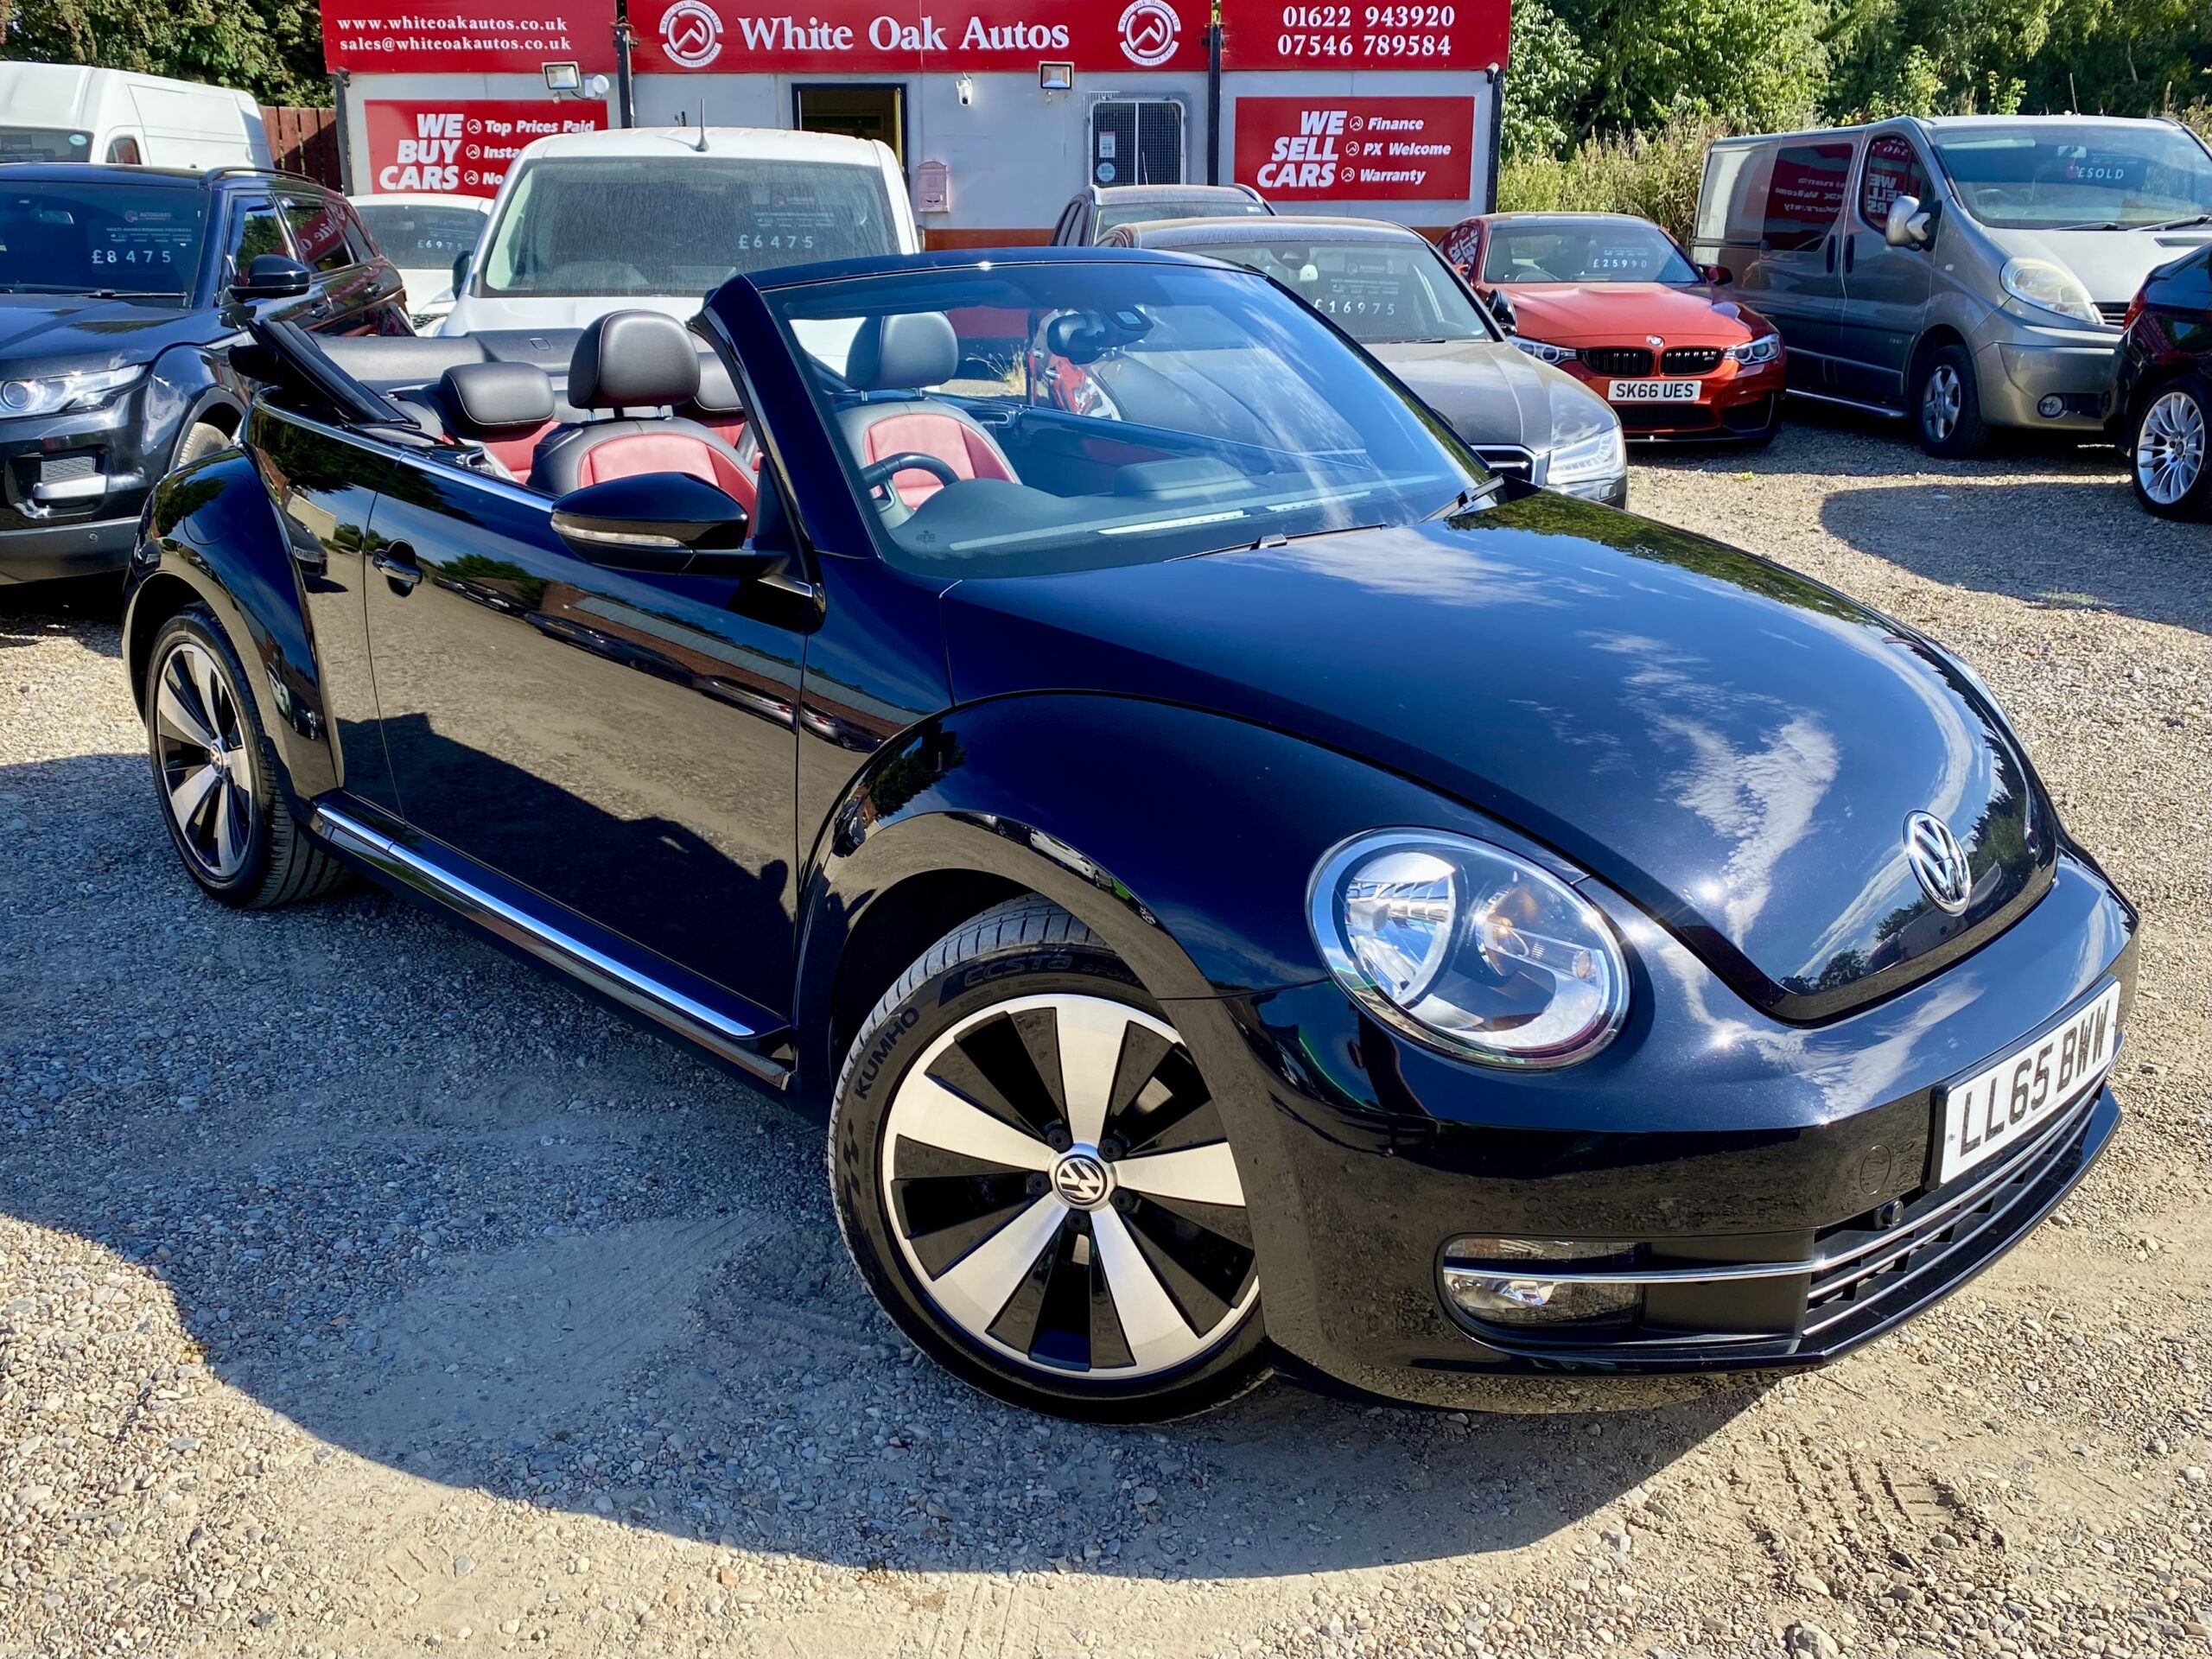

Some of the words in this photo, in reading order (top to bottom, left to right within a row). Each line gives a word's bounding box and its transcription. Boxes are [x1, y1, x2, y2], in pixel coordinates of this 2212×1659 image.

[337, 16, 567, 31] www.whiteoakautos.co.uk
[1282, 6, 1351, 27] 01622
[1365, 6, 1455, 28] 943920
[737, 16, 855, 50] White
[868, 16, 948, 50] Oak
[958, 16, 1070, 50] Autos
[340, 36, 571, 52] sales@whiteoakautos.co.uk
[1277, 35, 1353, 56] 07546
[1363, 35, 1452, 56] 789584
[416, 113, 464, 138] WE
[485, 120, 512, 137] Top
[516, 120, 558, 133] Prices
[563, 120, 595, 133] Paid
[1300, 111, 1348, 135] WE
[1368, 118, 1424, 130] Finance
[397, 140, 461, 164] BUY
[483, 146, 521, 159] Insta
[1271, 137, 1338, 162] SELL
[1363, 143, 1382, 156] PX
[1389, 142, 1452, 156] Welcome
[379, 165, 459, 190] CARS
[482, 172, 504, 185] No
[1257, 162, 1336, 188] CARS
[1360, 168, 1427, 184] Warranty
[416, 239, 463, 251] £6975
[738, 234, 813, 249] £6475
[92, 249, 171, 264] £8475
[1592, 258, 1647, 268] £25990
[1313, 298, 1395, 315] £16975
[1616, 383, 1659, 398] SK66
[1662, 382, 1694, 398] UES
[854, 1007, 921, 1100] KUMHO
[1960, 1043, 2054, 1158] LL65
[2057, 999, 2110, 1094] BWW
